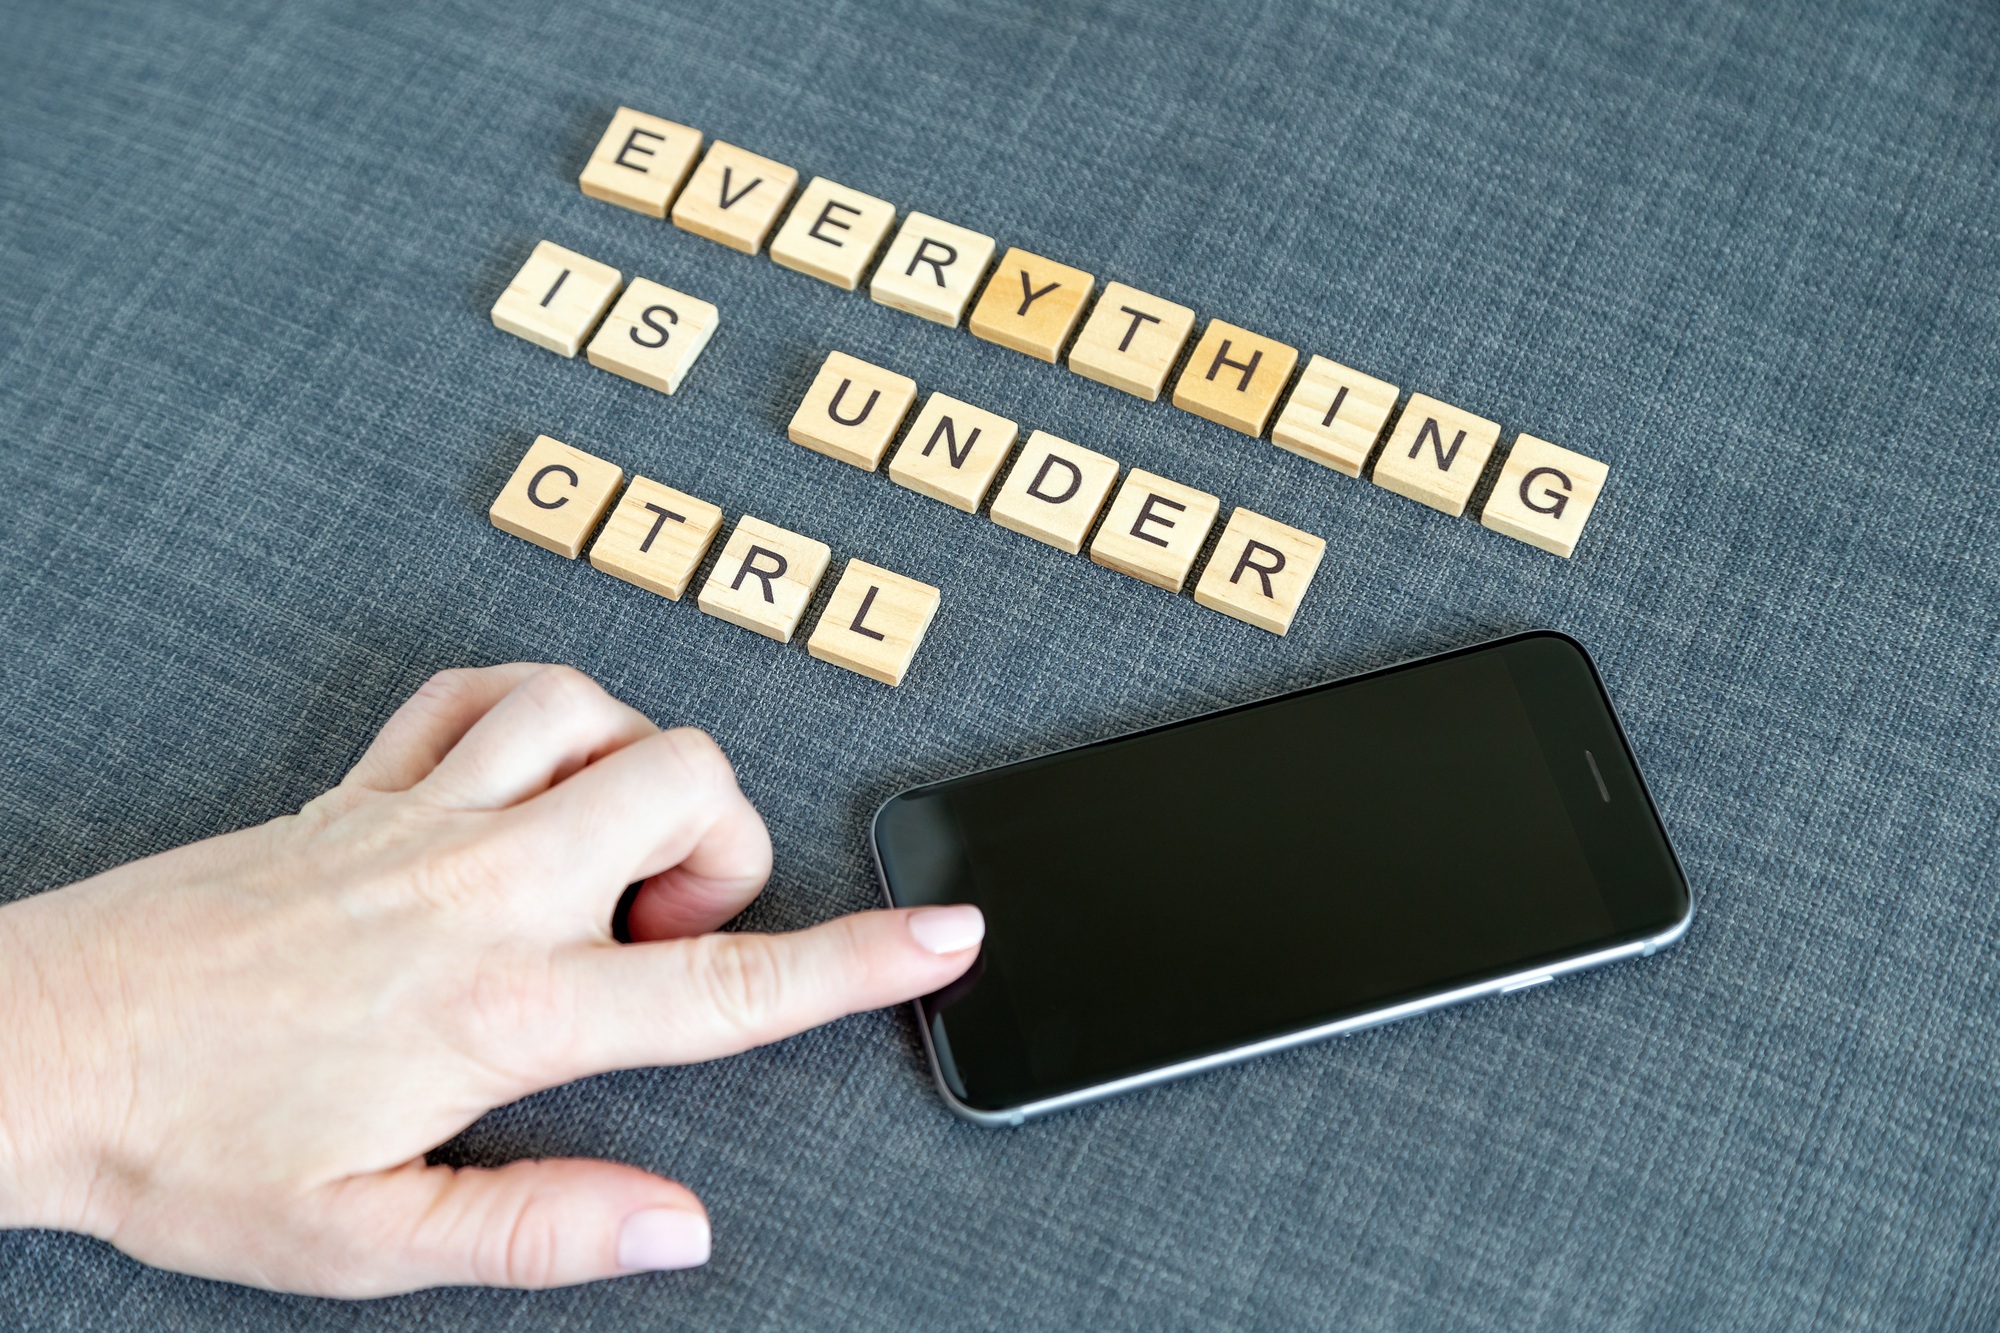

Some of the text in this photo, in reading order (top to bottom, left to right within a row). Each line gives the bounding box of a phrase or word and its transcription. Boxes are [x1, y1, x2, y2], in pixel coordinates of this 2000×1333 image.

[540, 268, 1286, 600] IS UNDER
[614, 127, 1574, 520] EVERYTHING
[526, 464, 885, 643] CTRL
